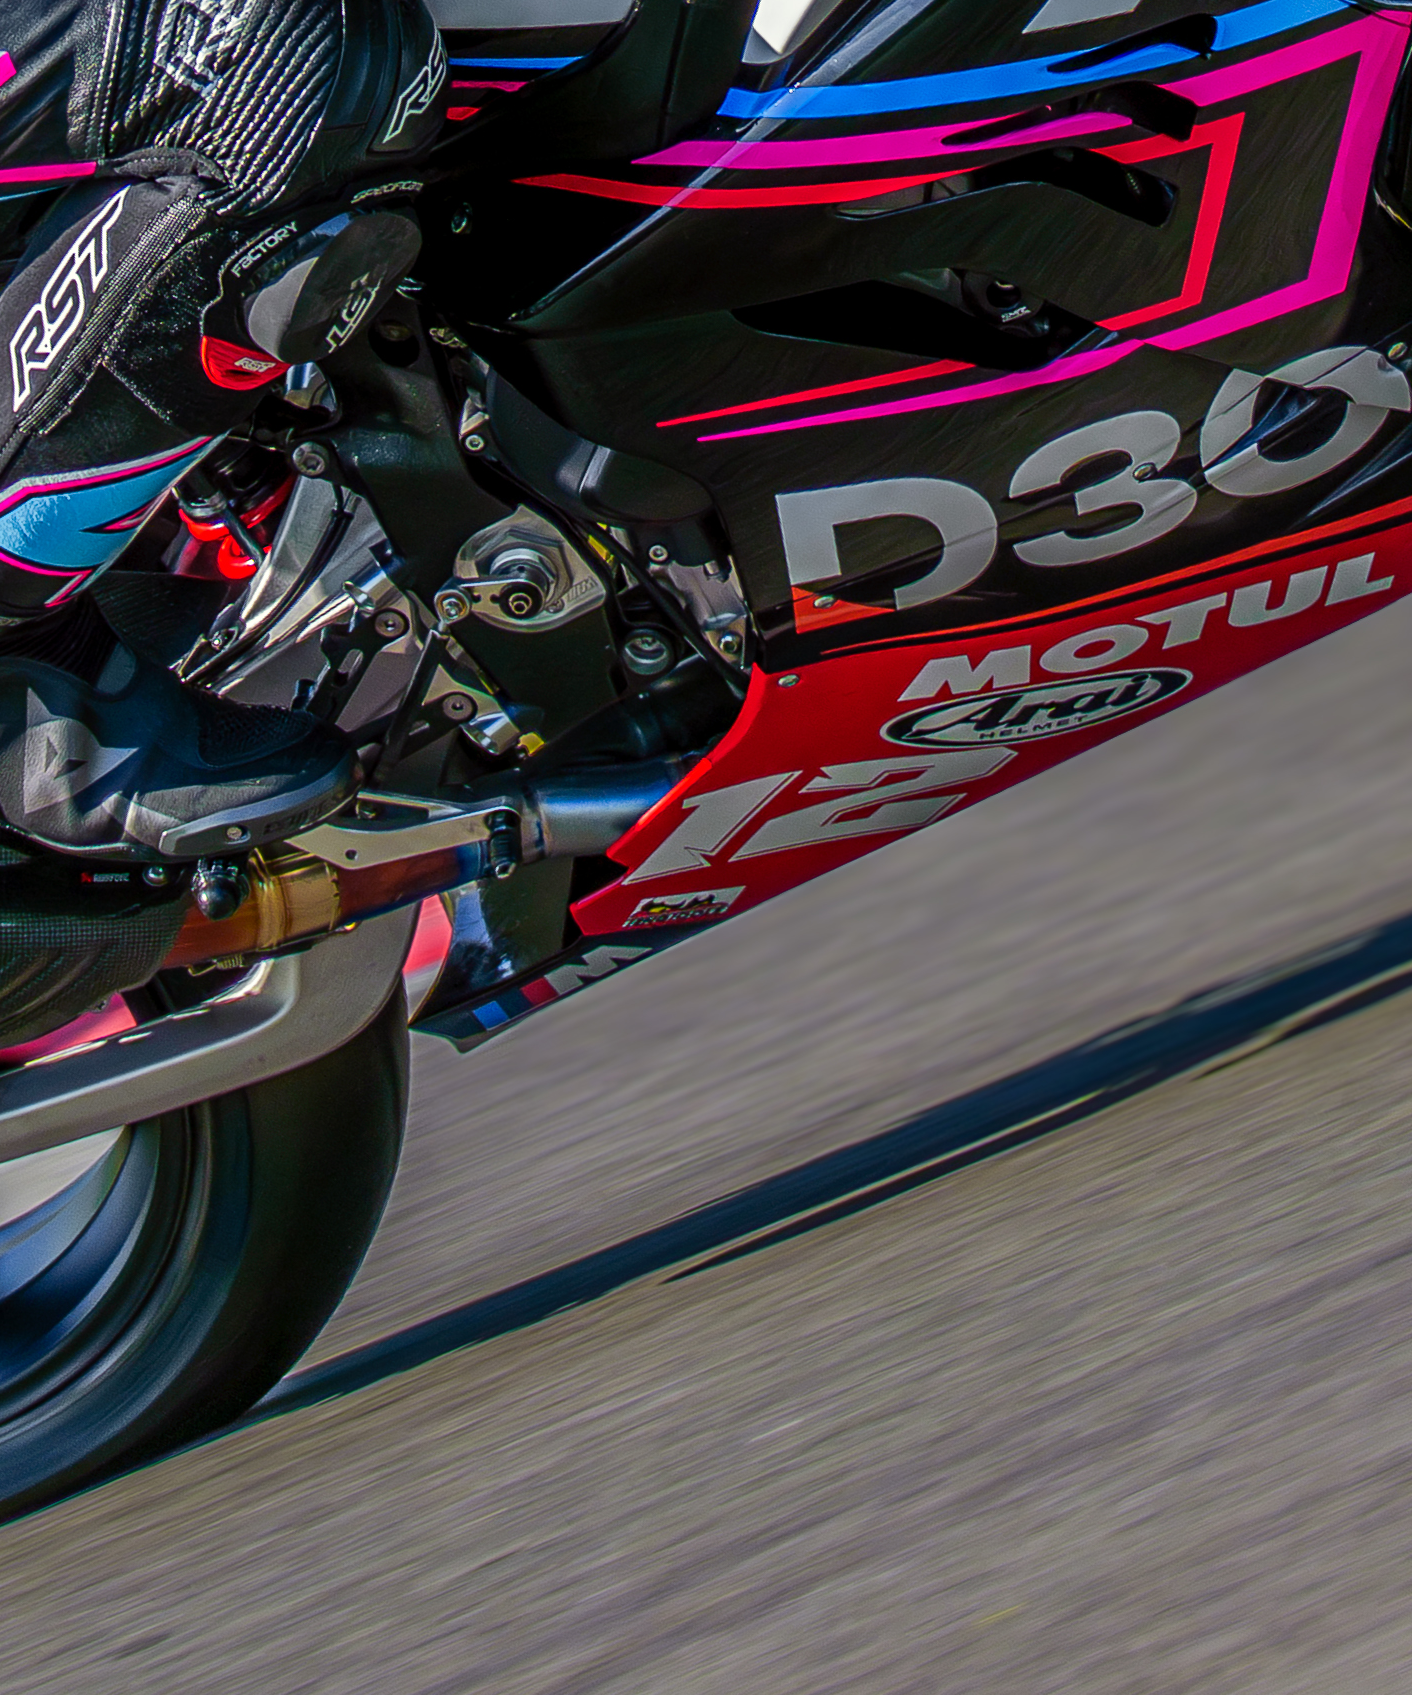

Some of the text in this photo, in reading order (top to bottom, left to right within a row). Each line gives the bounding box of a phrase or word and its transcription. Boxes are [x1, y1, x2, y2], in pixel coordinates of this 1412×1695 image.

[382, 27, 447, 144] RS
[11, 185, 130, 413] RST
[896, 552, 1395, 703] MOTUL
[904, 672, 1163, 738] Arai
[978, 714, 1088, 742] HELMET
[621, 745, 1018, 886] 12
